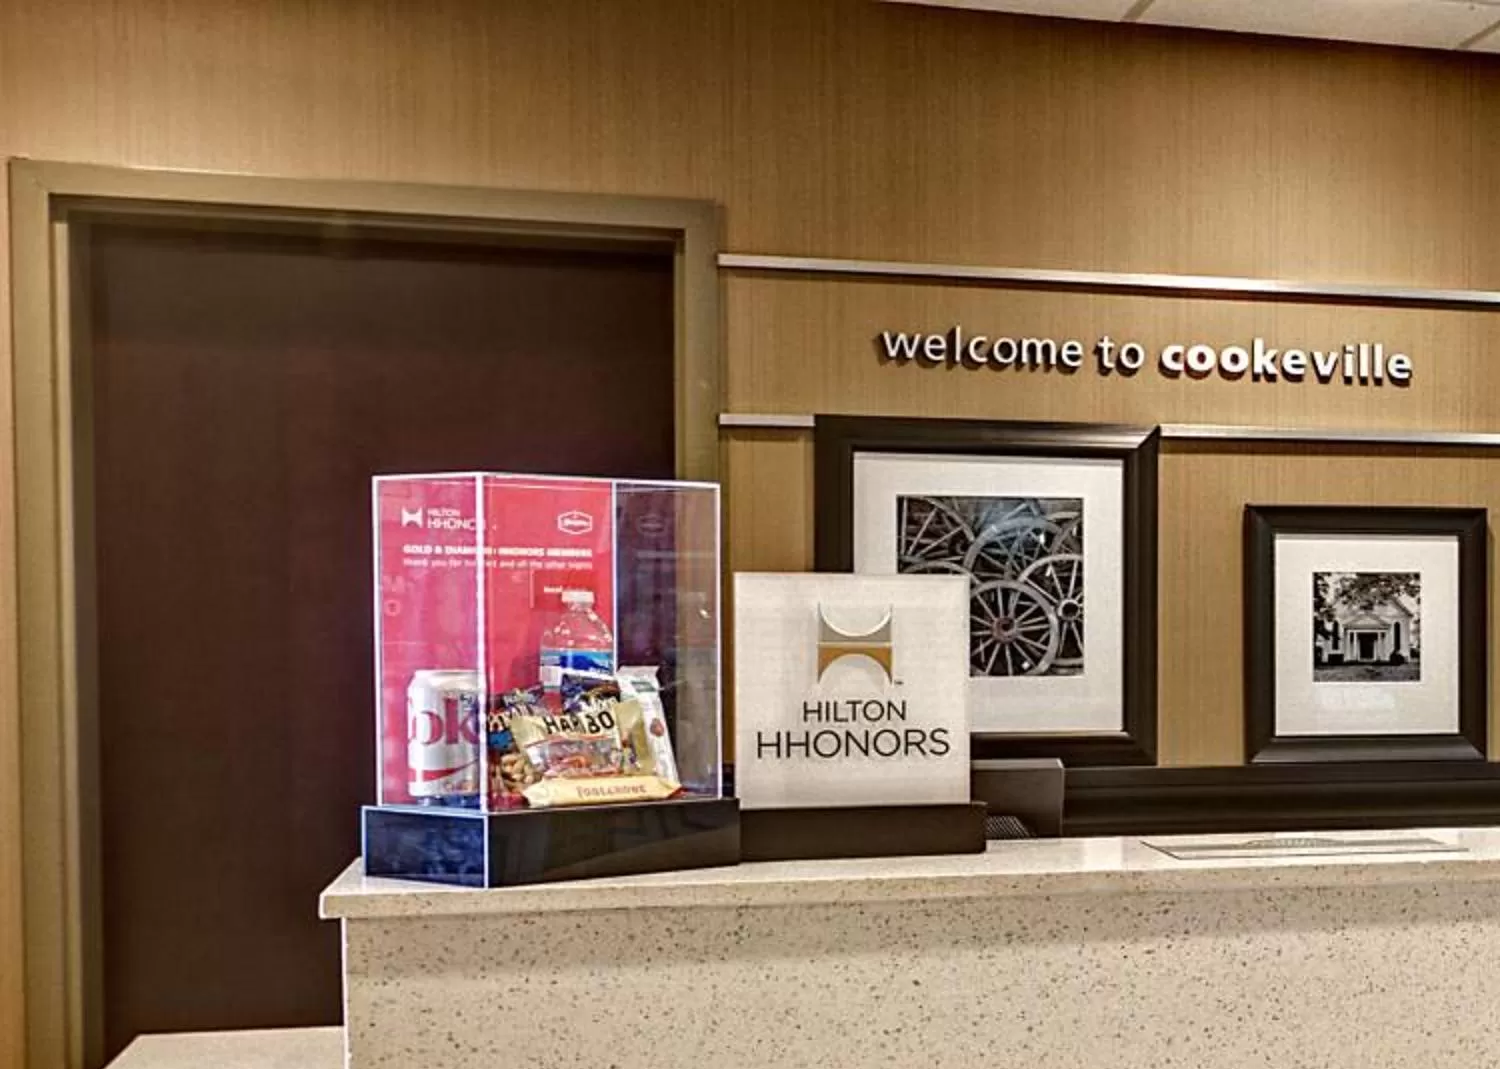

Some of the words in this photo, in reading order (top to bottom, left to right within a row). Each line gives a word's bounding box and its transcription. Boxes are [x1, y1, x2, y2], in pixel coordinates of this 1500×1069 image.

[881, 325, 1085, 369] welcome
[1096, 335, 1146, 370] to
[1160, 337, 1414, 380] cookeville
[803, 699, 907, 723] HILTON
[756, 727, 950, 759] HHONORS
